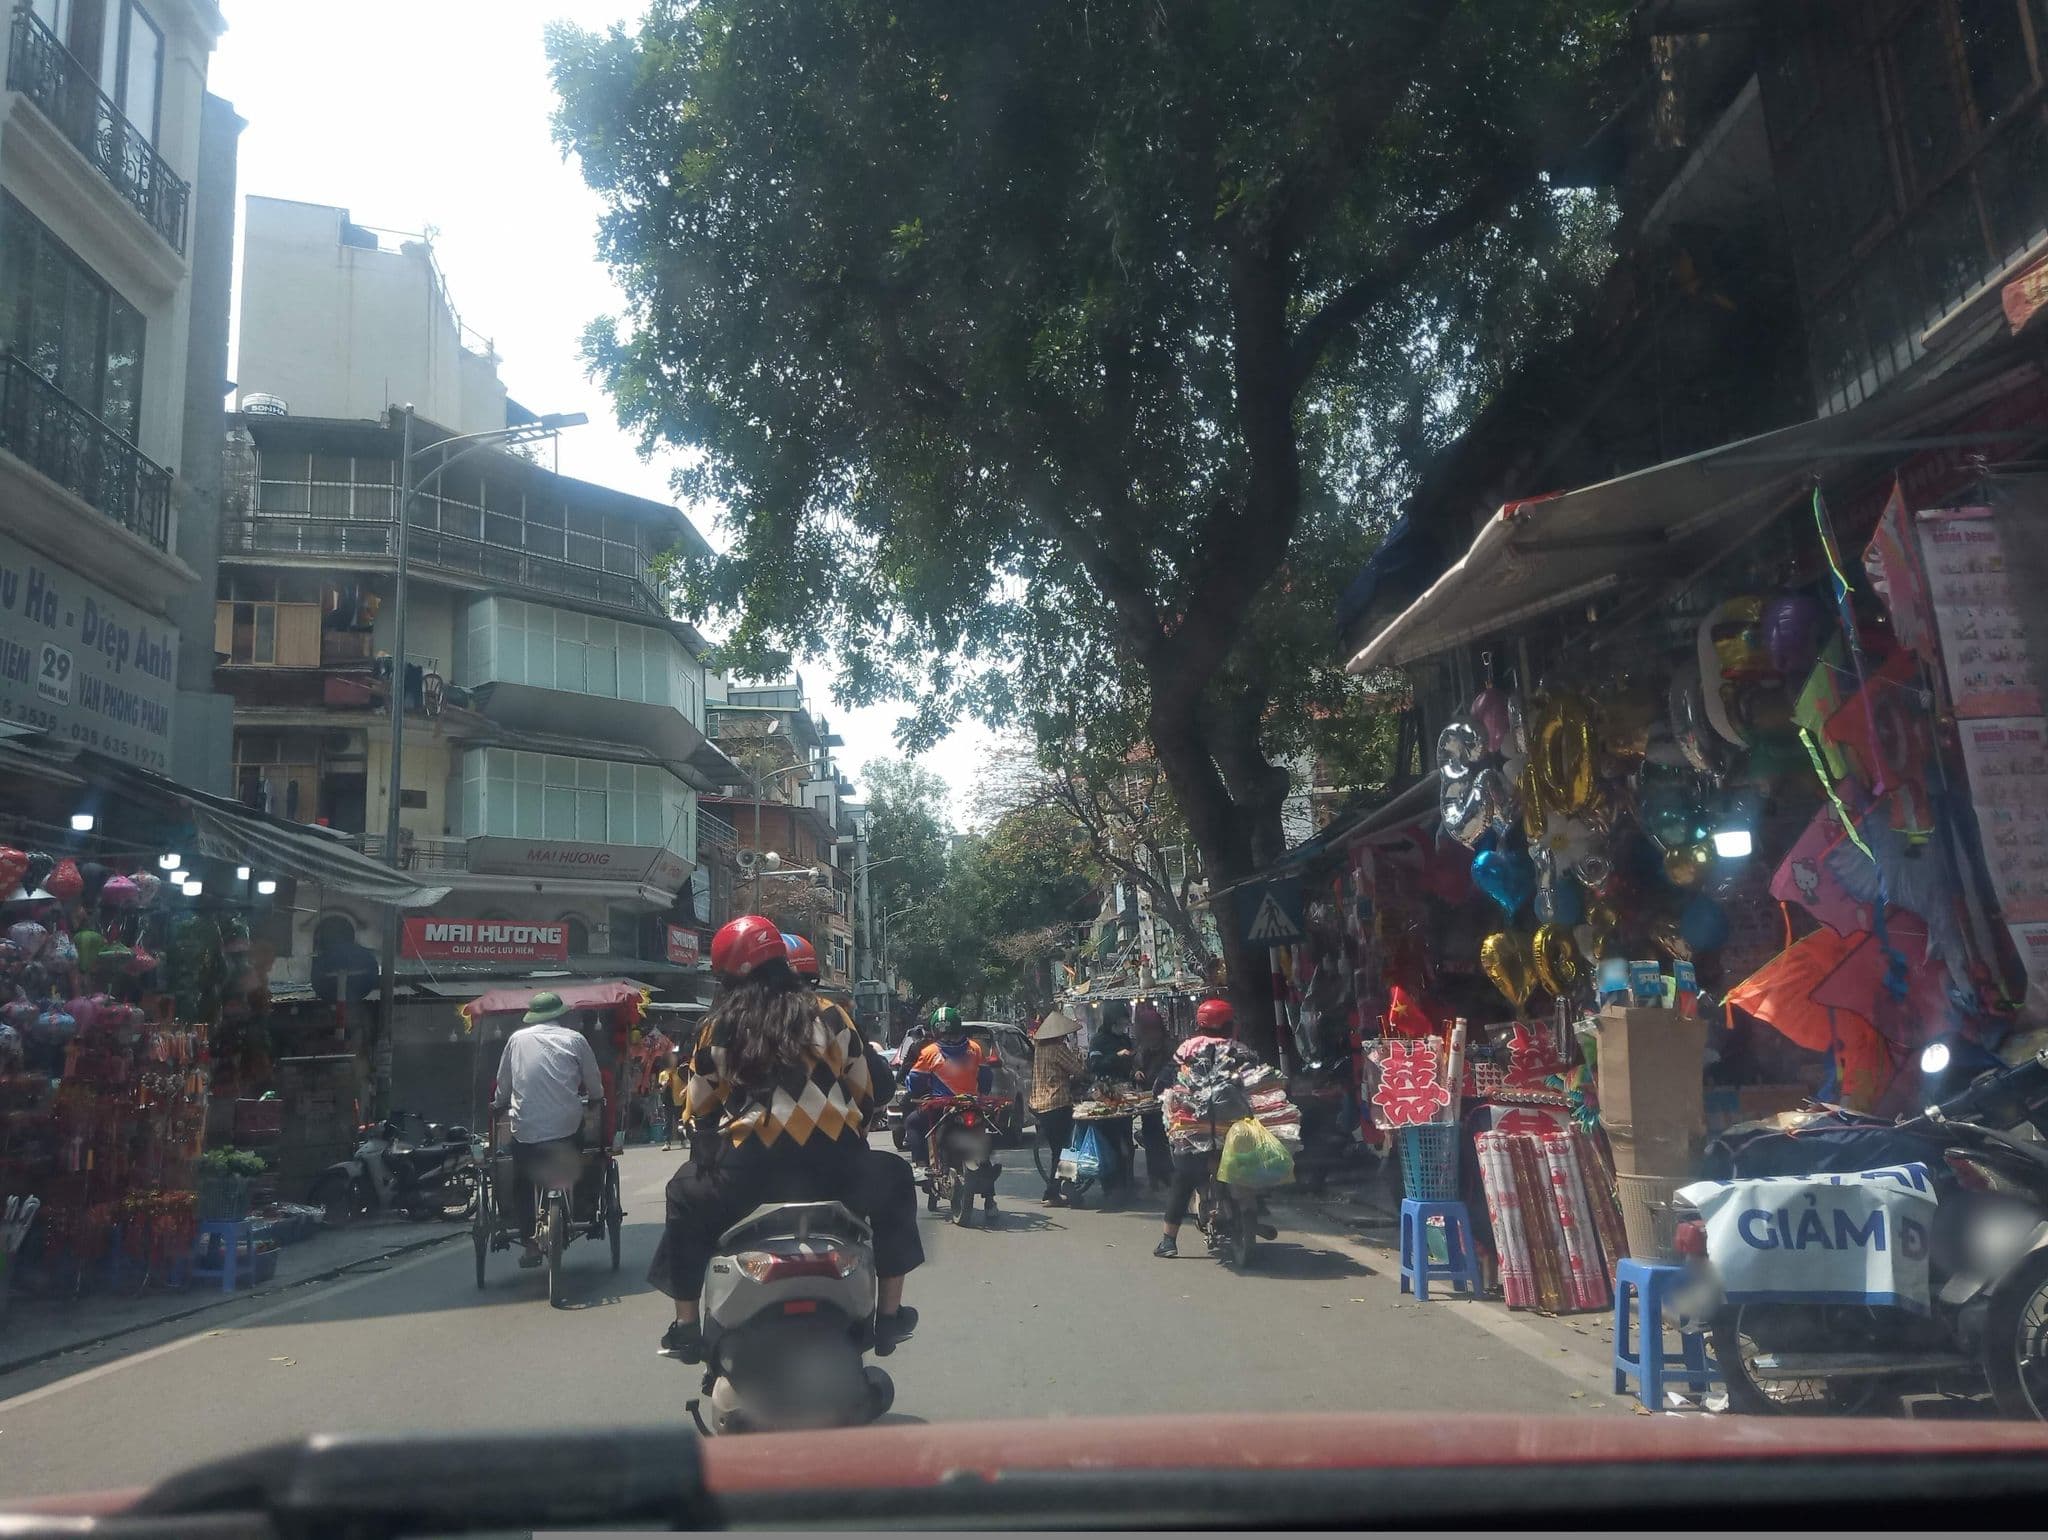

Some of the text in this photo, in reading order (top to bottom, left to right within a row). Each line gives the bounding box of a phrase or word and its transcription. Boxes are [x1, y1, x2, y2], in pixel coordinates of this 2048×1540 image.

[42, 647, 71, 682] 29
[134, 625, 172, 683] Anh
[527, 848, 557, 863] MAI
[425, 923, 562, 944] MAI HƯƠNG
[1737, 1191, 1886, 1251] GIẢM
